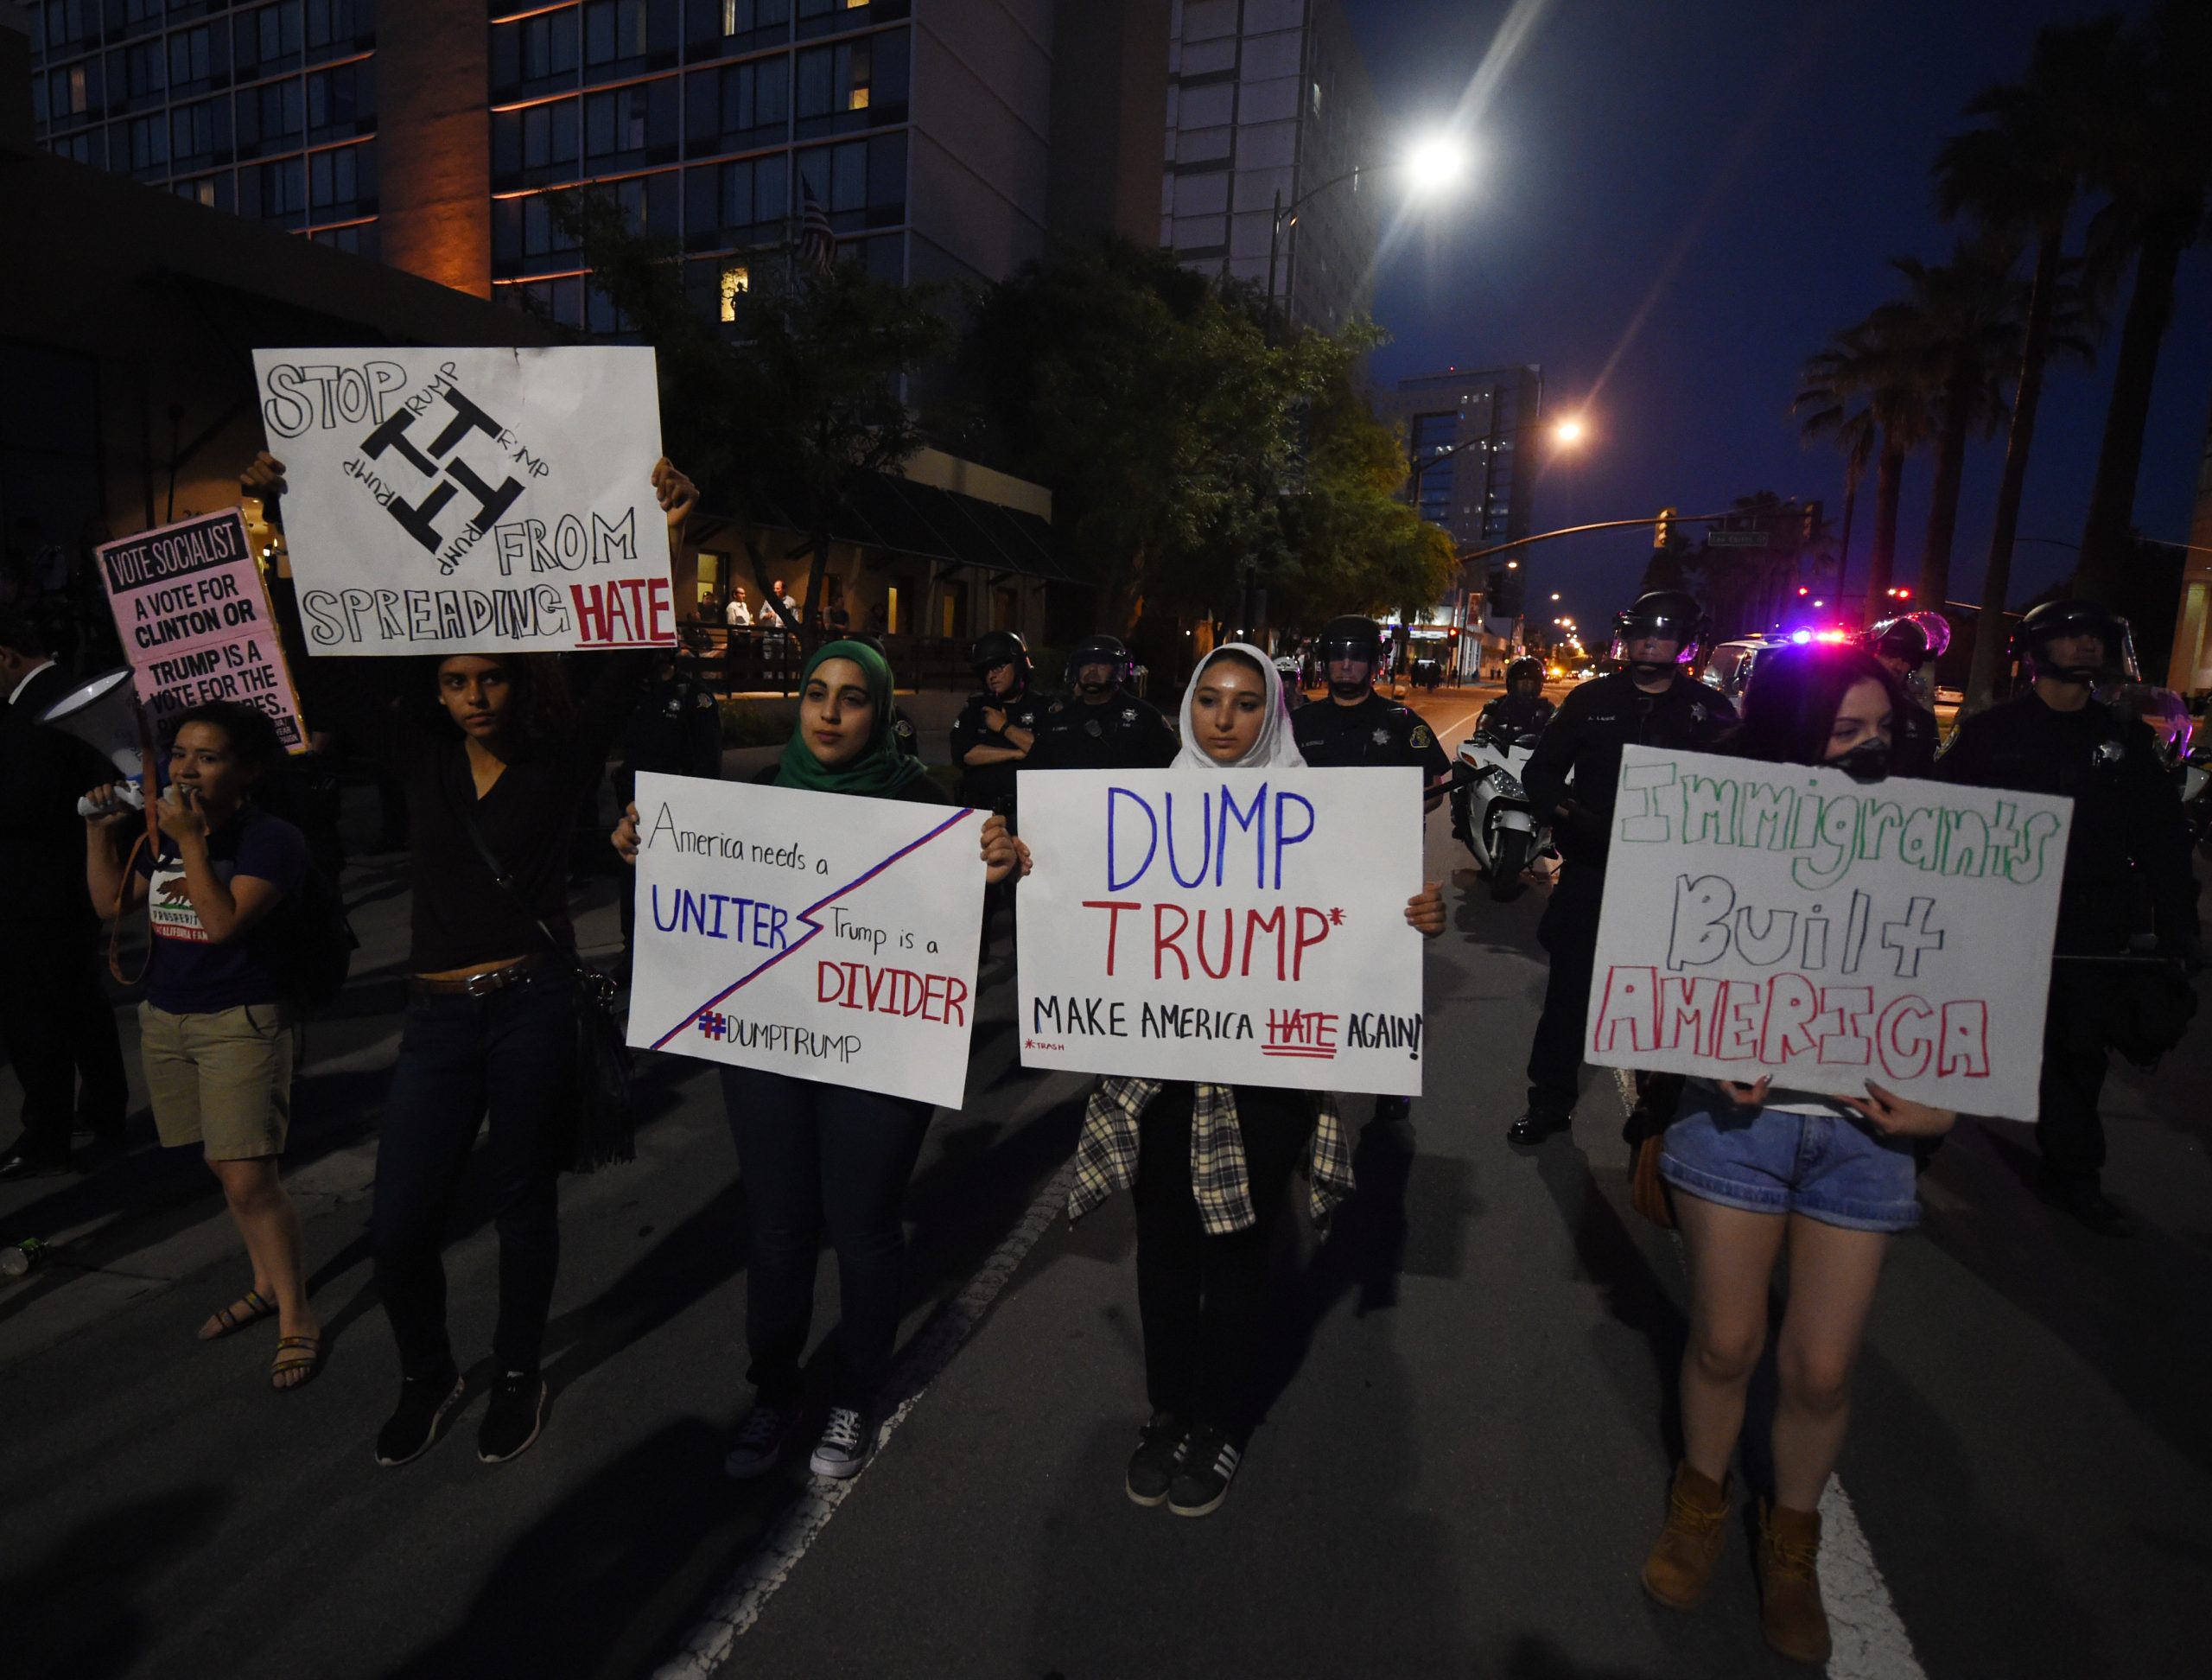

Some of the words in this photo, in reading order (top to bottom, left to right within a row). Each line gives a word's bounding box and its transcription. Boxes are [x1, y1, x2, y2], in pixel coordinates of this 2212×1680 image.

[264, 361, 407, 438] STOP
[111, 546, 154, 586] VOTE
[152, 522, 236, 574] SOCIALIST
[494, 506, 637, 576] FROM
[135, 598, 149, 621] A
[147, 583, 197, 615] VOTE
[198, 573, 239, 604] FOR
[135, 611, 221, 648] CLINTON
[223, 598, 257, 627] OR
[302, 584, 571, 645] SPREADING
[569, 577, 675, 642] HATE
[149, 650, 220, 686] TRUMP
[222, 644, 243, 668] IS
[248, 640, 262, 663] A
[149, 684, 197, 715] VOTE
[197, 676, 236, 703] FOR
[238, 665, 277, 690] THE
[648, 802, 744, 860] America
[752, 843, 806, 870] needs
[817, 858, 829, 875] a
[1108, 781, 1314, 892] DUMP
[1621, 762, 2061, 890] Immigrants
[652, 884, 788, 950] UNITER
[830, 907, 887, 955] Trump
[899, 929, 913, 949] is
[926, 939, 938, 954] a
[1667, 874, 1943, 977] Built
[817, 960, 967, 1027] DIVIDER
[1593, 965, 1989, 1079] AMERICA
[698, 1010, 861, 1064] #DUMPTRUMP
[1034, 995, 1128, 1036] MAKE
[1142, 1002, 1254, 1040] AMERICA
[1266, 1009, 1338, 1047] HATE
[1347, 1013, 1423, 1060] AGAIN!
